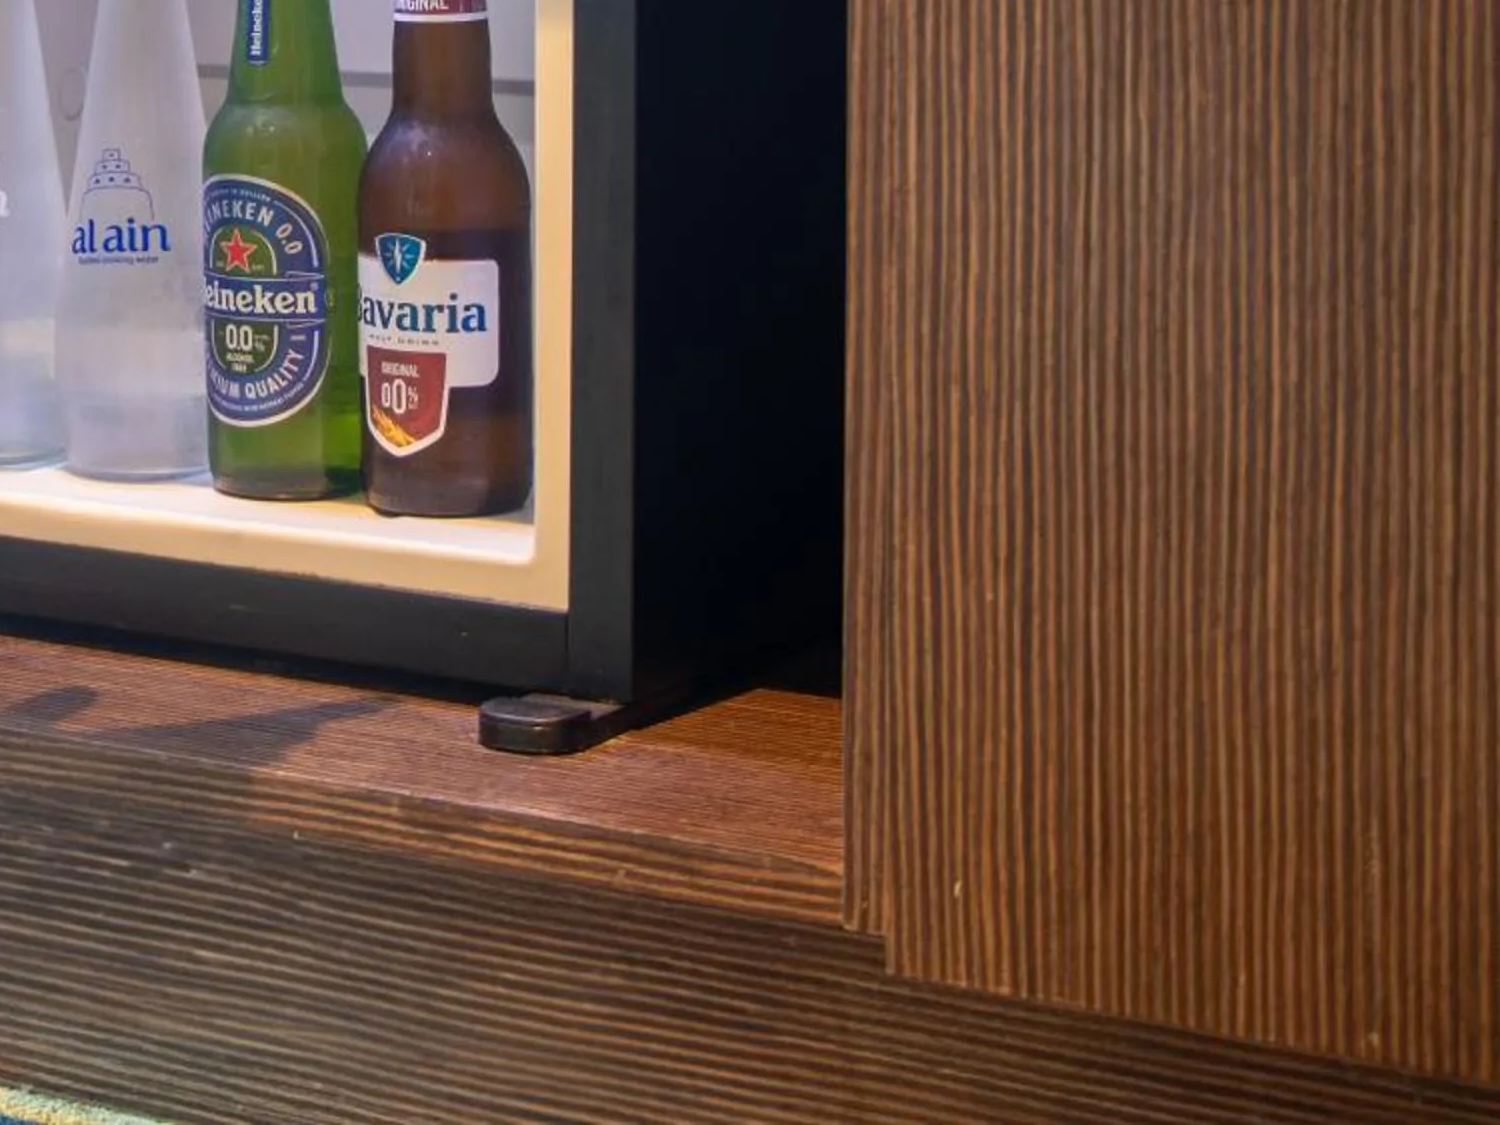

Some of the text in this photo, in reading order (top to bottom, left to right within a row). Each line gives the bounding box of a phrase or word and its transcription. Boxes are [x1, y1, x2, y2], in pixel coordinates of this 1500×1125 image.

[71, 216, 172, 254] al ain
[275, 222, 303, 254] 0.0
[201, 277, 317, 314] eineken
[244, 347, 305, 400] QUALITY
